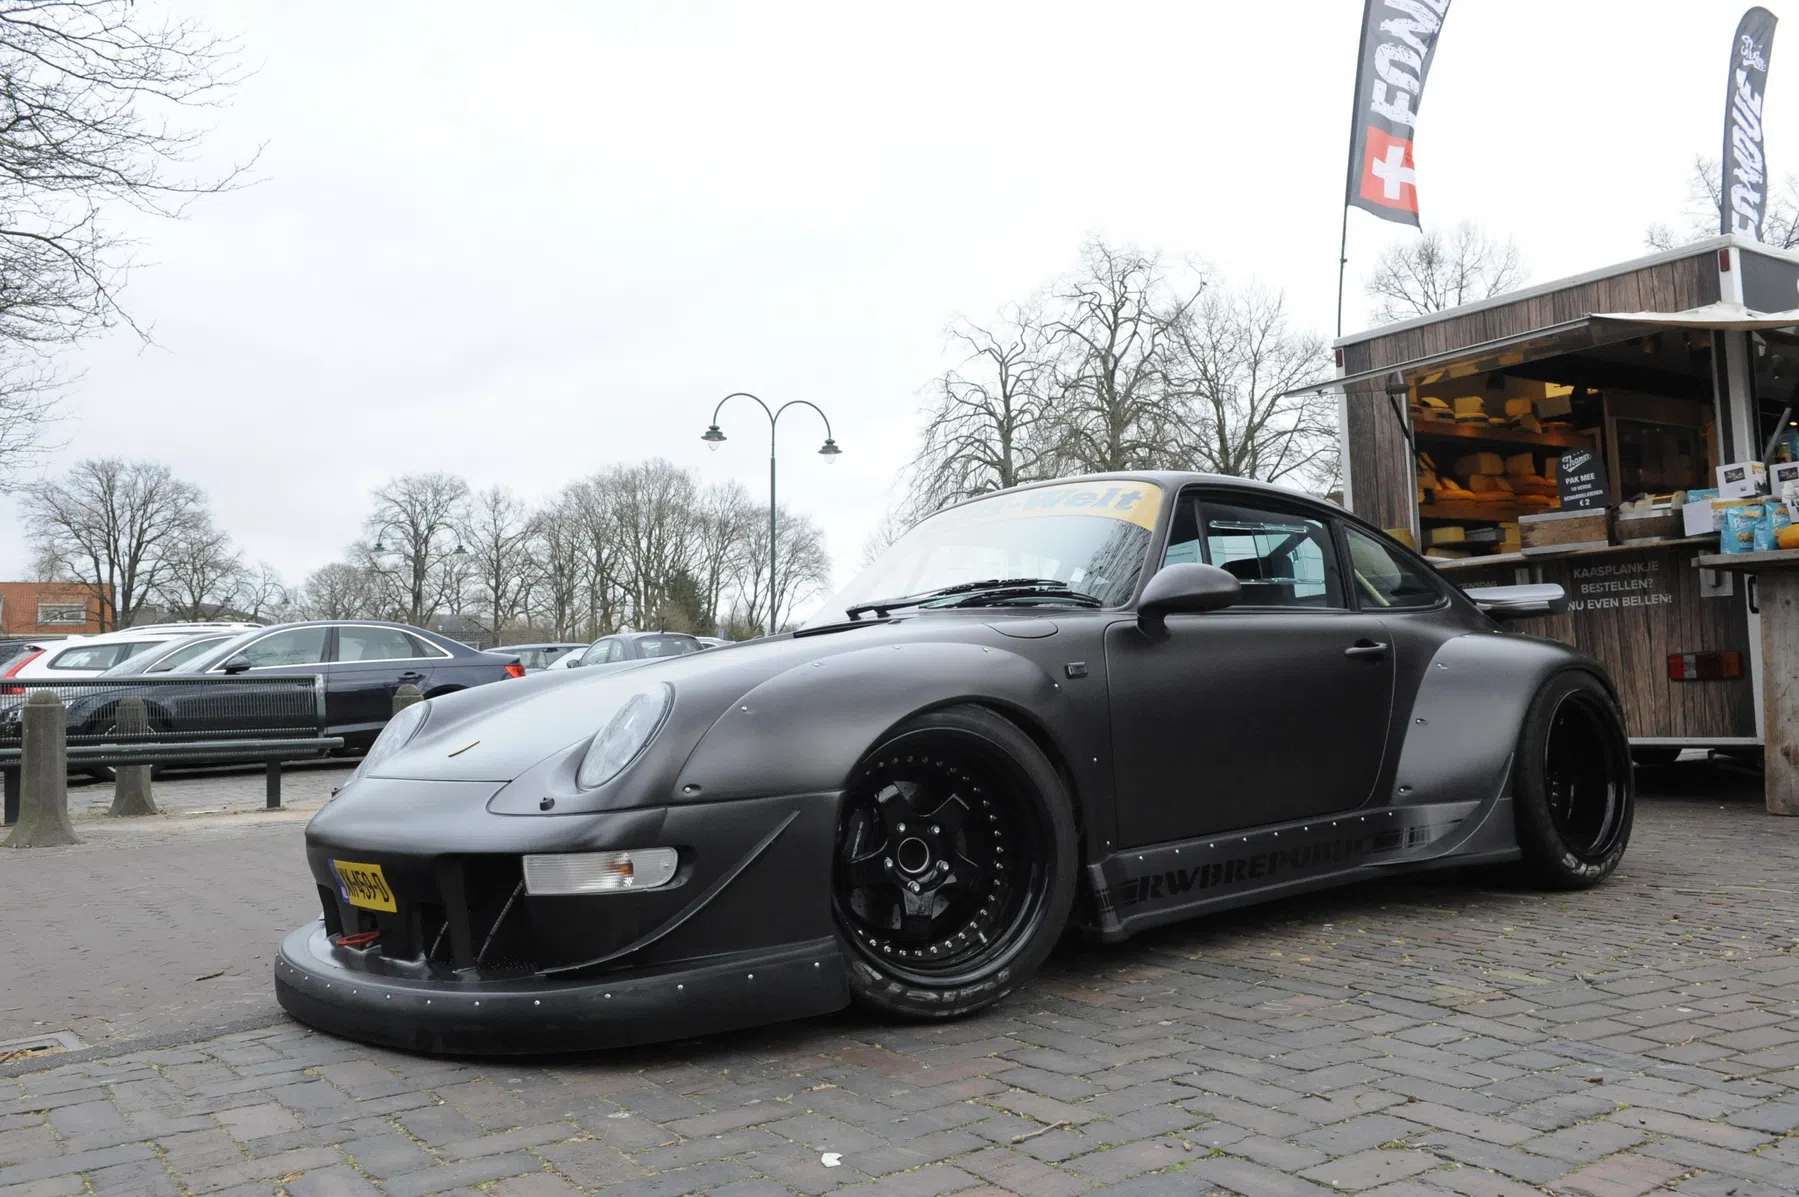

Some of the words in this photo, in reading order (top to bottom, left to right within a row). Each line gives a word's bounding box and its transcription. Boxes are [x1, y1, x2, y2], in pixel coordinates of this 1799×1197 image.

[1565, 476, 1580, 485] PAK
[1580, 472, 1596, 482] MEE
[1573, 561, 1659, 579] KAASPLANKJE
[1458, 580, 1498, 590] OENSDAG
[1581, 578, 1654, 594] BESTELLEN?
[1567, 600, 1584, 611] NU
[1587, 597, 1619, 610] EVEN
[1622, 593, 1672, 607] BELLEN!
